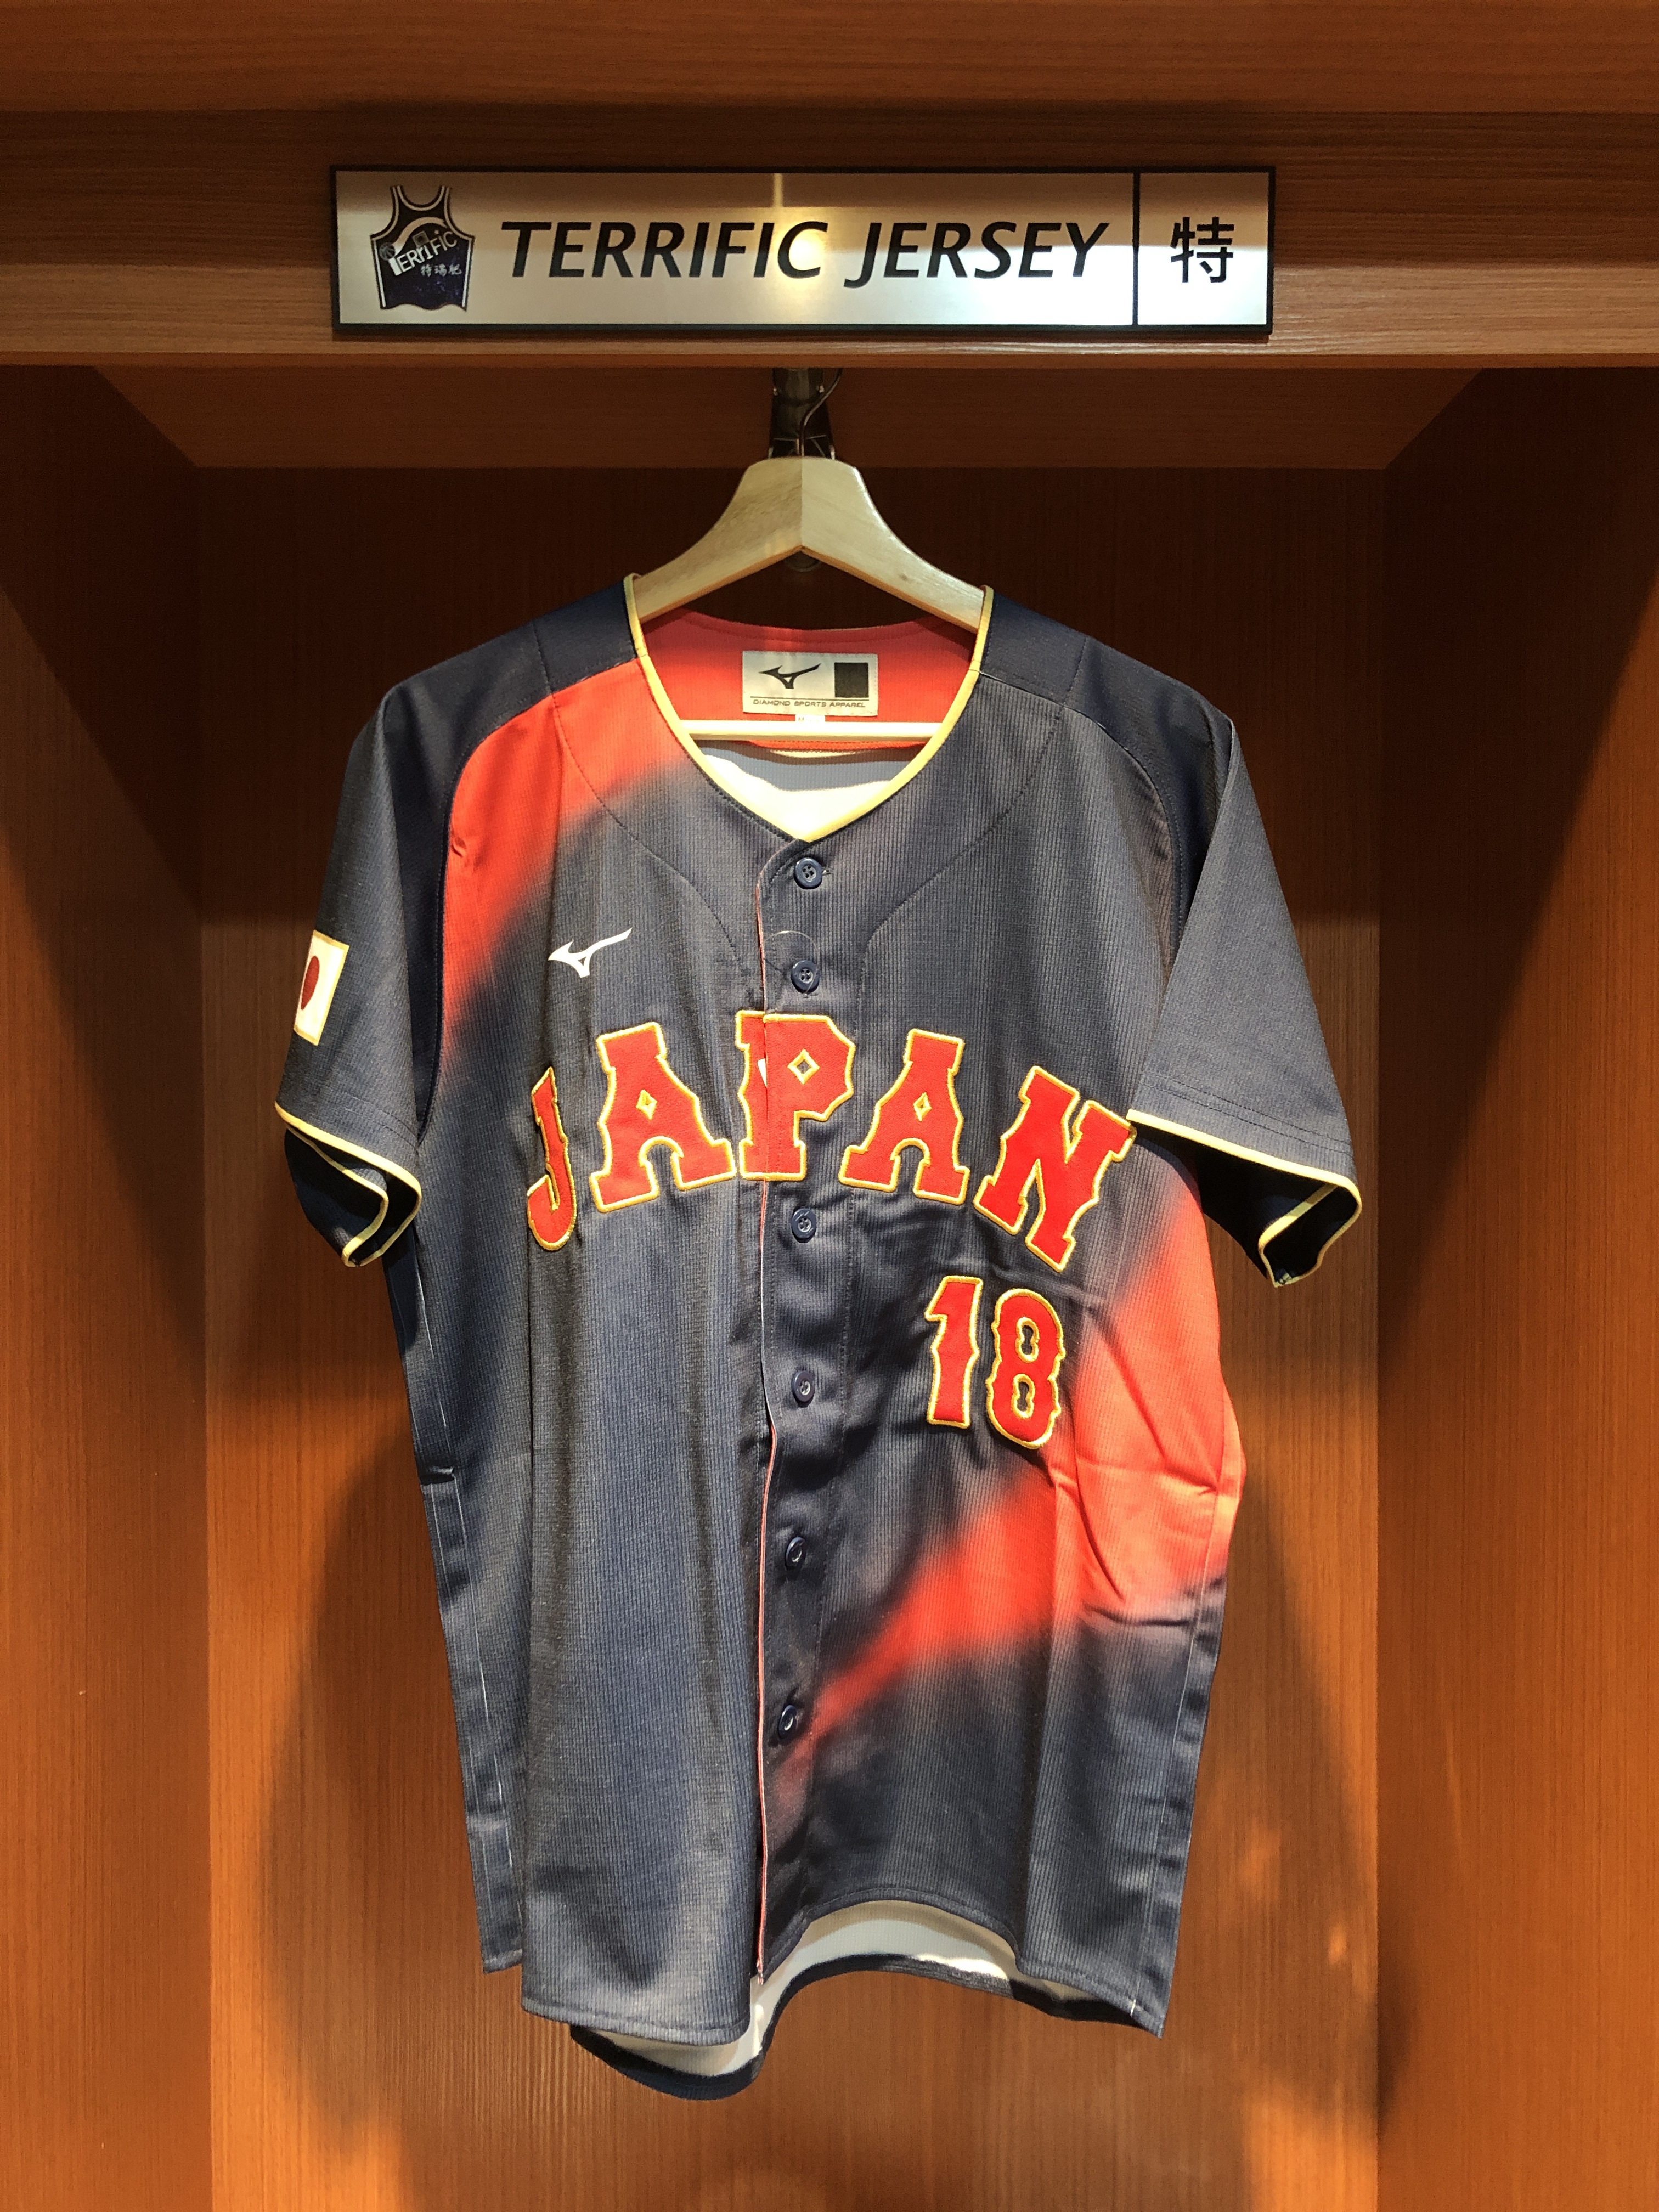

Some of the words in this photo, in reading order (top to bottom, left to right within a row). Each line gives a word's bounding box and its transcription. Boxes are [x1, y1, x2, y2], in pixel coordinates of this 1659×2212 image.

[501, 221, 828, 279] TERRIFIC
[844, 221, 1110, 289] JERSEY
[1170, 216, 1234, 283] 特
[527, 1009, 1137, 1272] JAPAN
[926, 1275, 1065, 1449] 18
